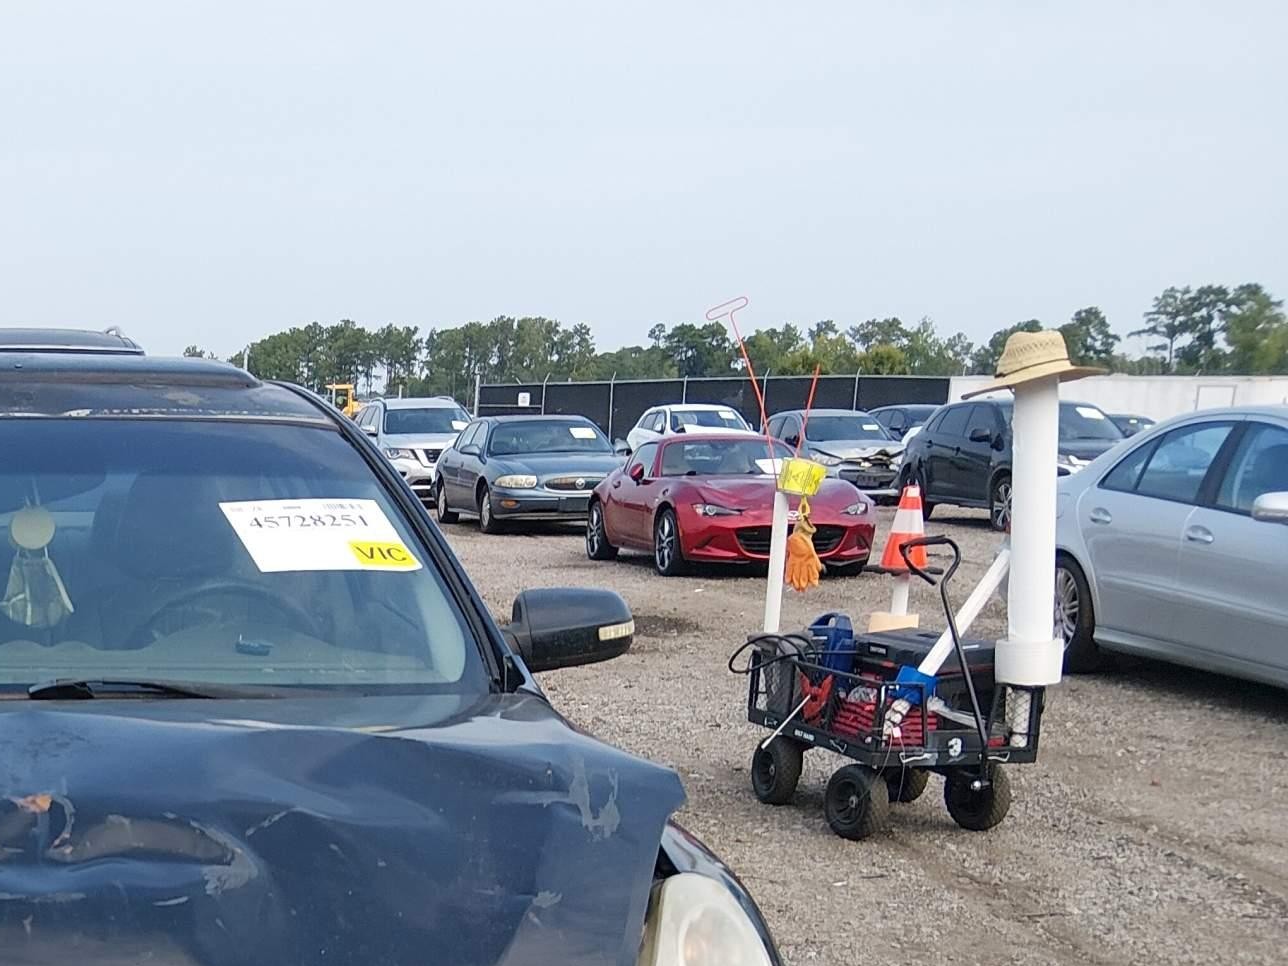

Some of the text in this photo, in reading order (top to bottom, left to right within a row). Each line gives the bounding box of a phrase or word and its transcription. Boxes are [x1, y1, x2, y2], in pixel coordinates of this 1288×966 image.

[249, 513, 368, 529] 45728251
[355, 546, 407, 562] VIC
[947, 737, 962, 757] 3
